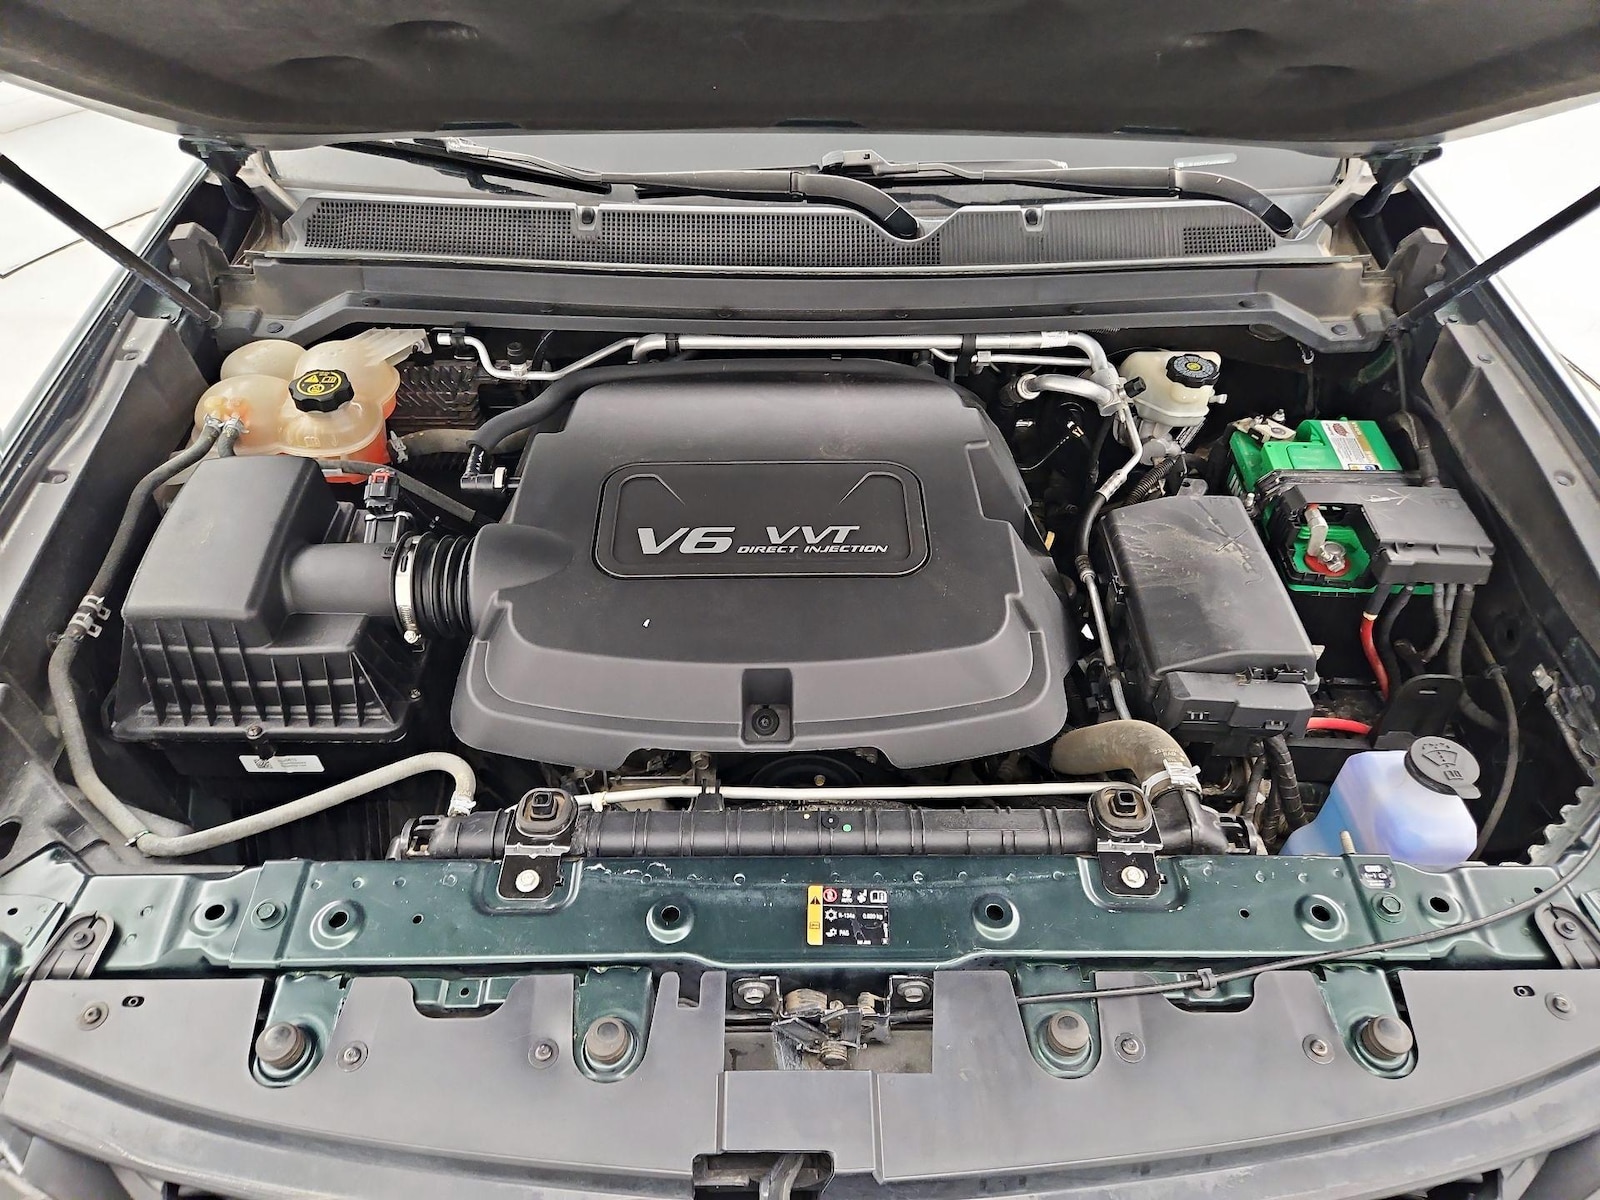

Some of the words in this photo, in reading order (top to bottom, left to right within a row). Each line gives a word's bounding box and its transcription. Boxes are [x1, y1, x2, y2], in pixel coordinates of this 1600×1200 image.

[637, 526, 736, 555] V6
[765, 525, 861, 544] VVT
[736, 545, 799, 554] DIRECT
[803, 545, 889, 553] INJECTION
